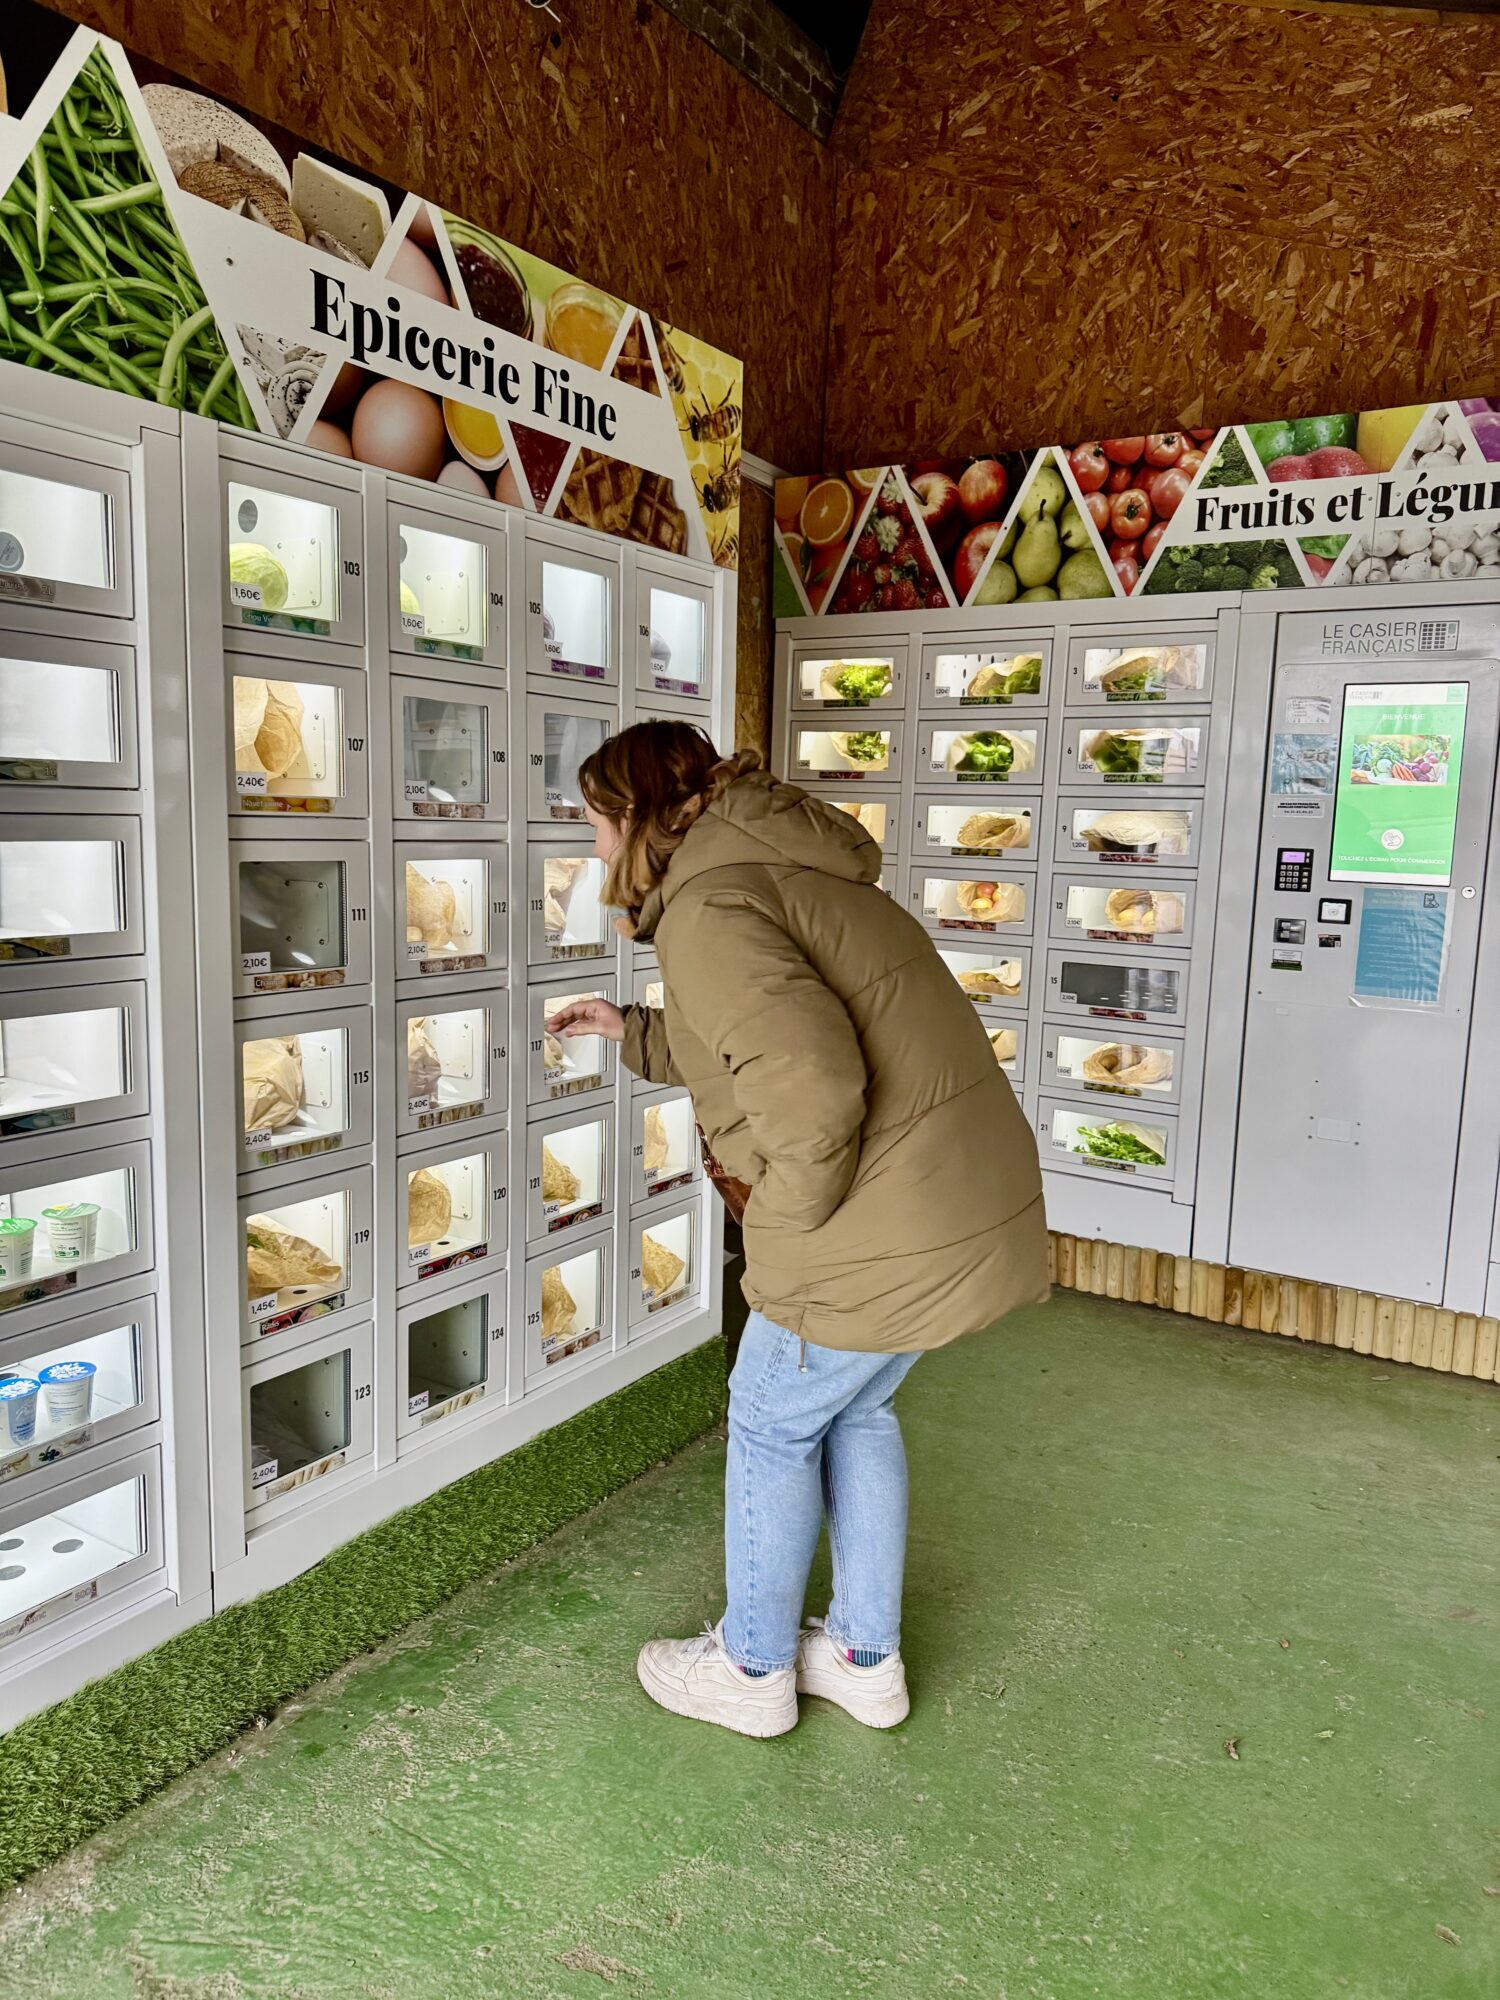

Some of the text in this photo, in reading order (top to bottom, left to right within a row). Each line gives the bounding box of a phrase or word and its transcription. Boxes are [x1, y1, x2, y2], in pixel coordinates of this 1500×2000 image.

[309, 267, 618, 442] Epicerie Fine
[1193, 487, 1316, 533] Fruits
[1326, 485, 1368, 524] et
[343, 560, 360, 577] 103
[234, 587, 261, 601] 1,60€
[490, 592, 503, 607] 104
[529, 601, 541, 615] 105
[402, 617, 423, 630] 1,60€
[1323, 621, 1417, 639] LE CASIER
[639, 625, 649, 638] 106
[544, 643, 561, 654] 1,60€
[1321, 638, 1415, 658] FRANÇAIS
[1073, 667, 1078, 676] 3
[347, 737, 364, 752] 107
[921, 747, 926, 755] 5
[1067, 747, 1072, 755] 6
[493, 750, 506, 763] 108
[530, 753, 543, 766] 109
[1078, 762, 1093, 770] 1,20€
[237, 776, 265, 788] 2,40€
[405, 785, 425, 795] 2,10€
[545, 791, 562, 801] 2,10€
[890, 819, 895, 827] 7
[917, 820, 922, 828] 8
[1072, 840, 1087, 849] 1,20€
[1407, 857, 1446, 865] COMMENCER
[493, 902, 507, 913] 112
[531, 899, 543, 911] 113
[1056, 901, 1063, 910] 12
[352, 908, 366, 921] 111
[408, 945, 426, 955] 2,10€
[243, 957, 268, 969] 2,10€
[1051, 976, 1058, 984] 15
[530, 1040, 542, 1052] 117
[493, 1046, 506, 1060] 116
[353, 1070, 369, 1085] 115
[408, 1099, 428, 1110] 2,40€
[1040, 1122, 1048, 1131] 21
[245, 1132, 271, 1146] 2,40€
[633, 1145, 643, 1157] 122
[529, 1176, 540, 1190] 121
[493, 1187, 506, 1200] 120
[543, 1203, 559, 1216] 1,45€
[354, 1229, 370, 1245] 119
[409, 1248, 429, 1262] 1,45€
[631, 1267, 641, 1280] 126
[251, 1299, 275, 1315] 1,45€
[527, 1311, 540, 1326] 125
[491, 1326, 504, 1341] 124
[354, 1384, 371, 1400] 123
[408, 1395, 428, 1411] 2,40€
[252, 1465, 276, 1481] 2,40€
